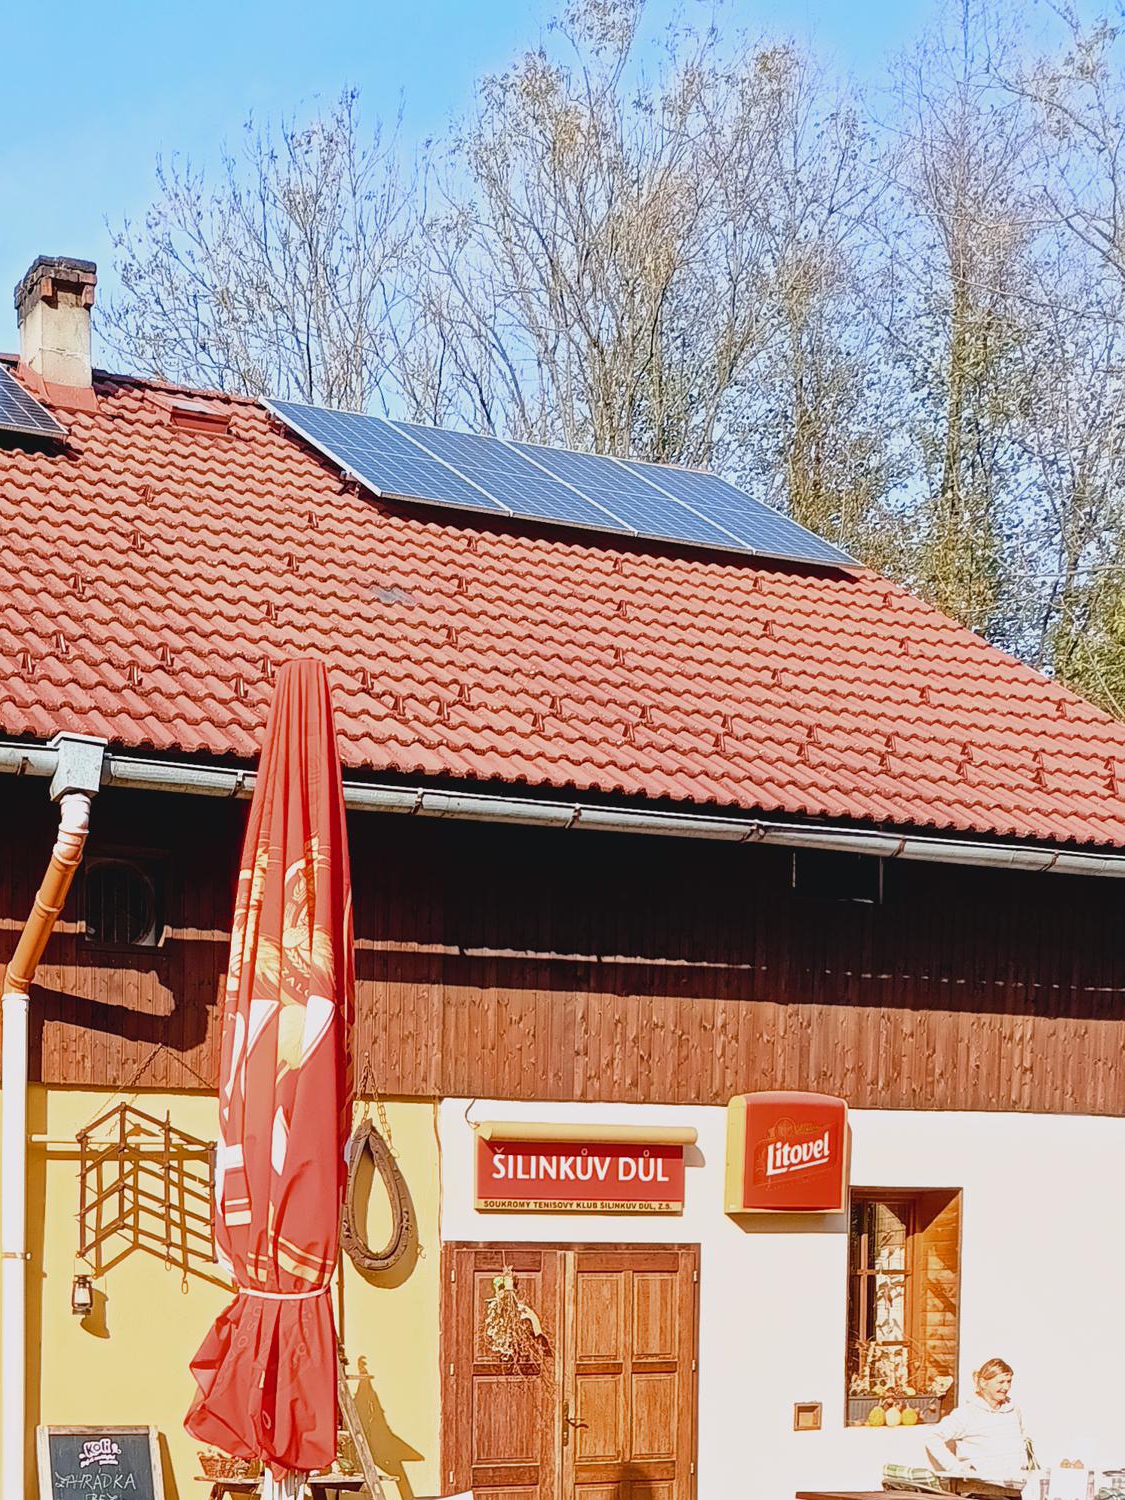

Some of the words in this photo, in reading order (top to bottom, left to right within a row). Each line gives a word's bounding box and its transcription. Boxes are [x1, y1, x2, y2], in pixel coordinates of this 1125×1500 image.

[492, 1146, 611, 1181] ŠILINKŮV
[618, 1149, 670, 1182] DŮL
[766, 1131, 830, 1176] Litovel
[55, 1468, 137, 1490] ZAHRÁDKA
